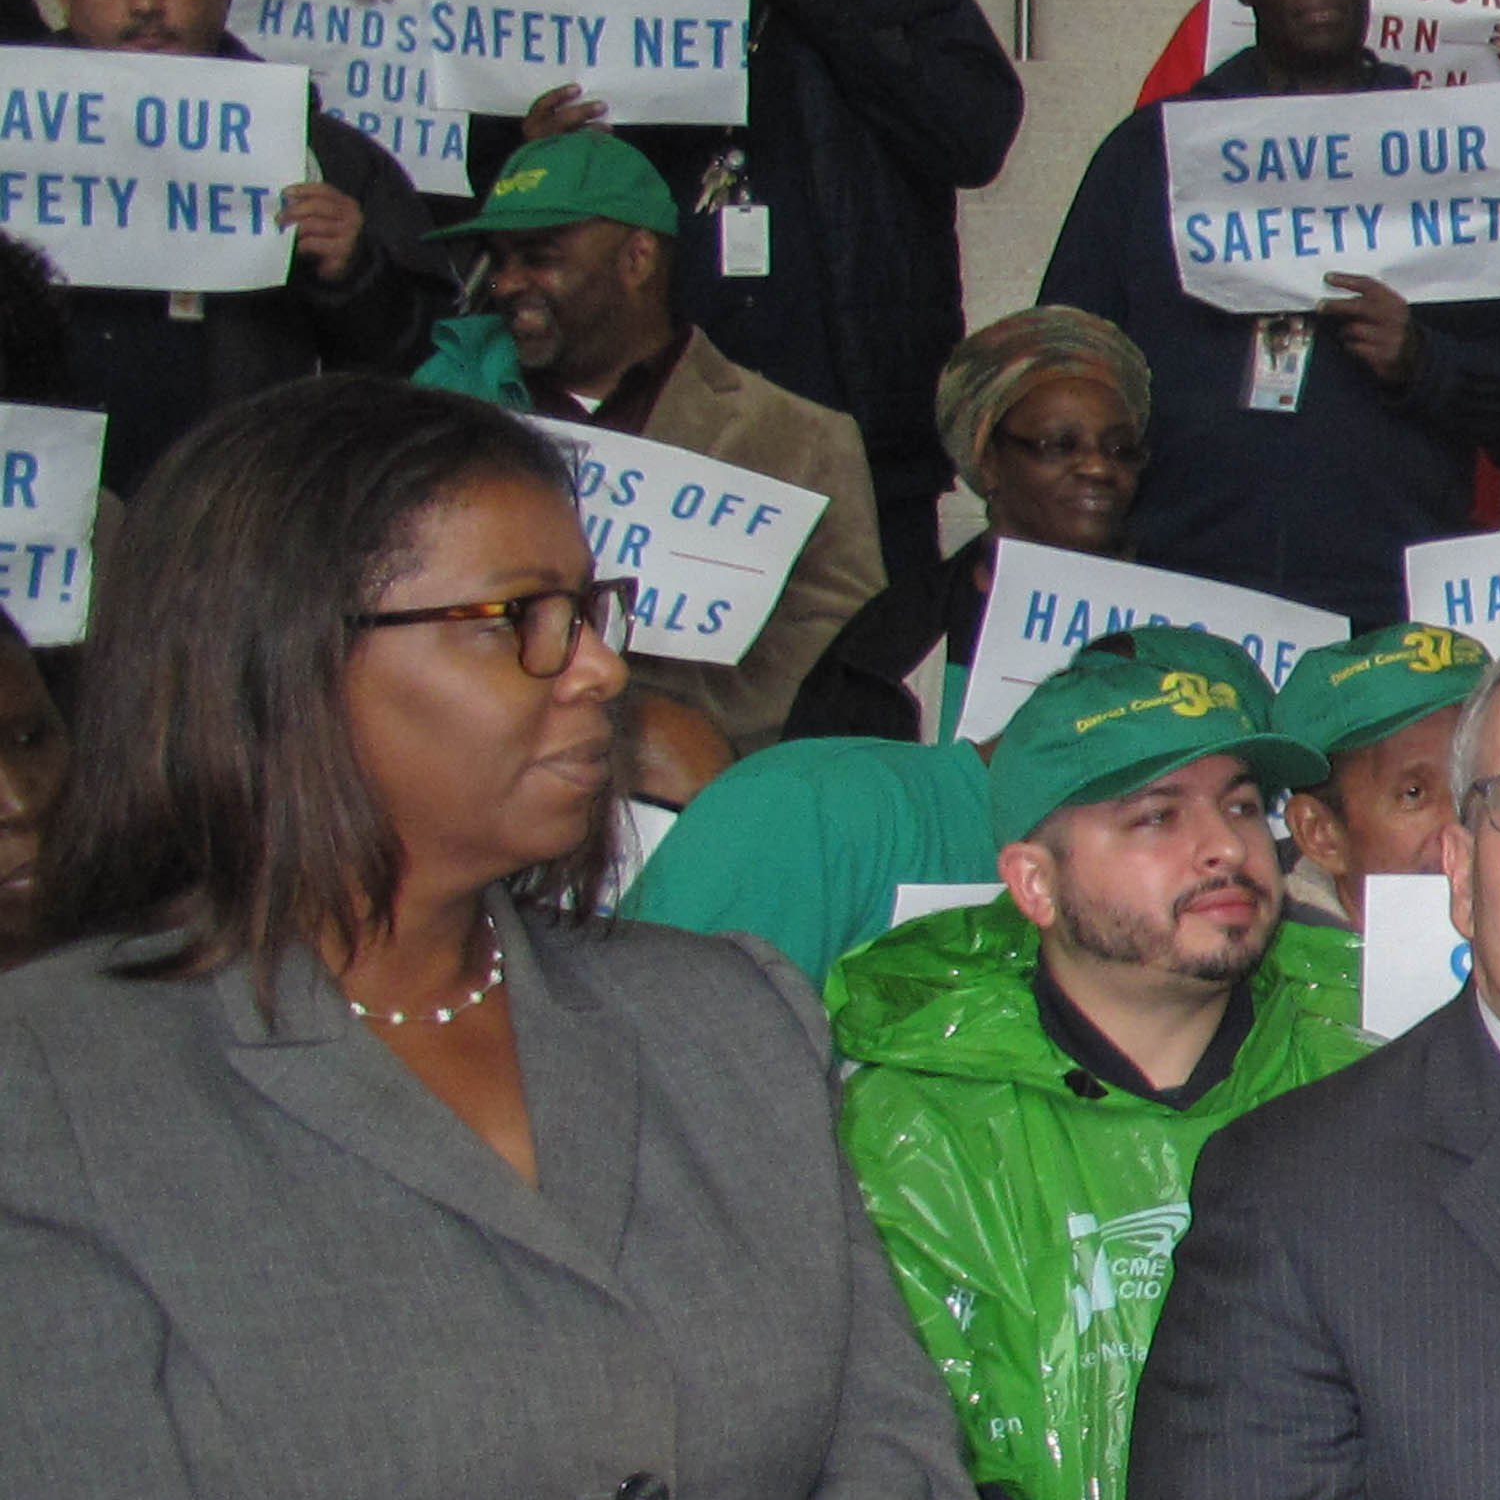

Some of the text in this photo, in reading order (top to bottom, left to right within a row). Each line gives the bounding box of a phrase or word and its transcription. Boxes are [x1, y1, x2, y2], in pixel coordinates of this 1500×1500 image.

[432, 1, 749, 69] SAFETY NET!
[0, 89, 251, 154] AVE OUR
[1222, 125, 1488, 183] SAVE OUR
[0, 171, 286, 236] FETY NET
[1186, 204, 1384, 264] SAFETY
[671, 483, 782, 536] OFF
